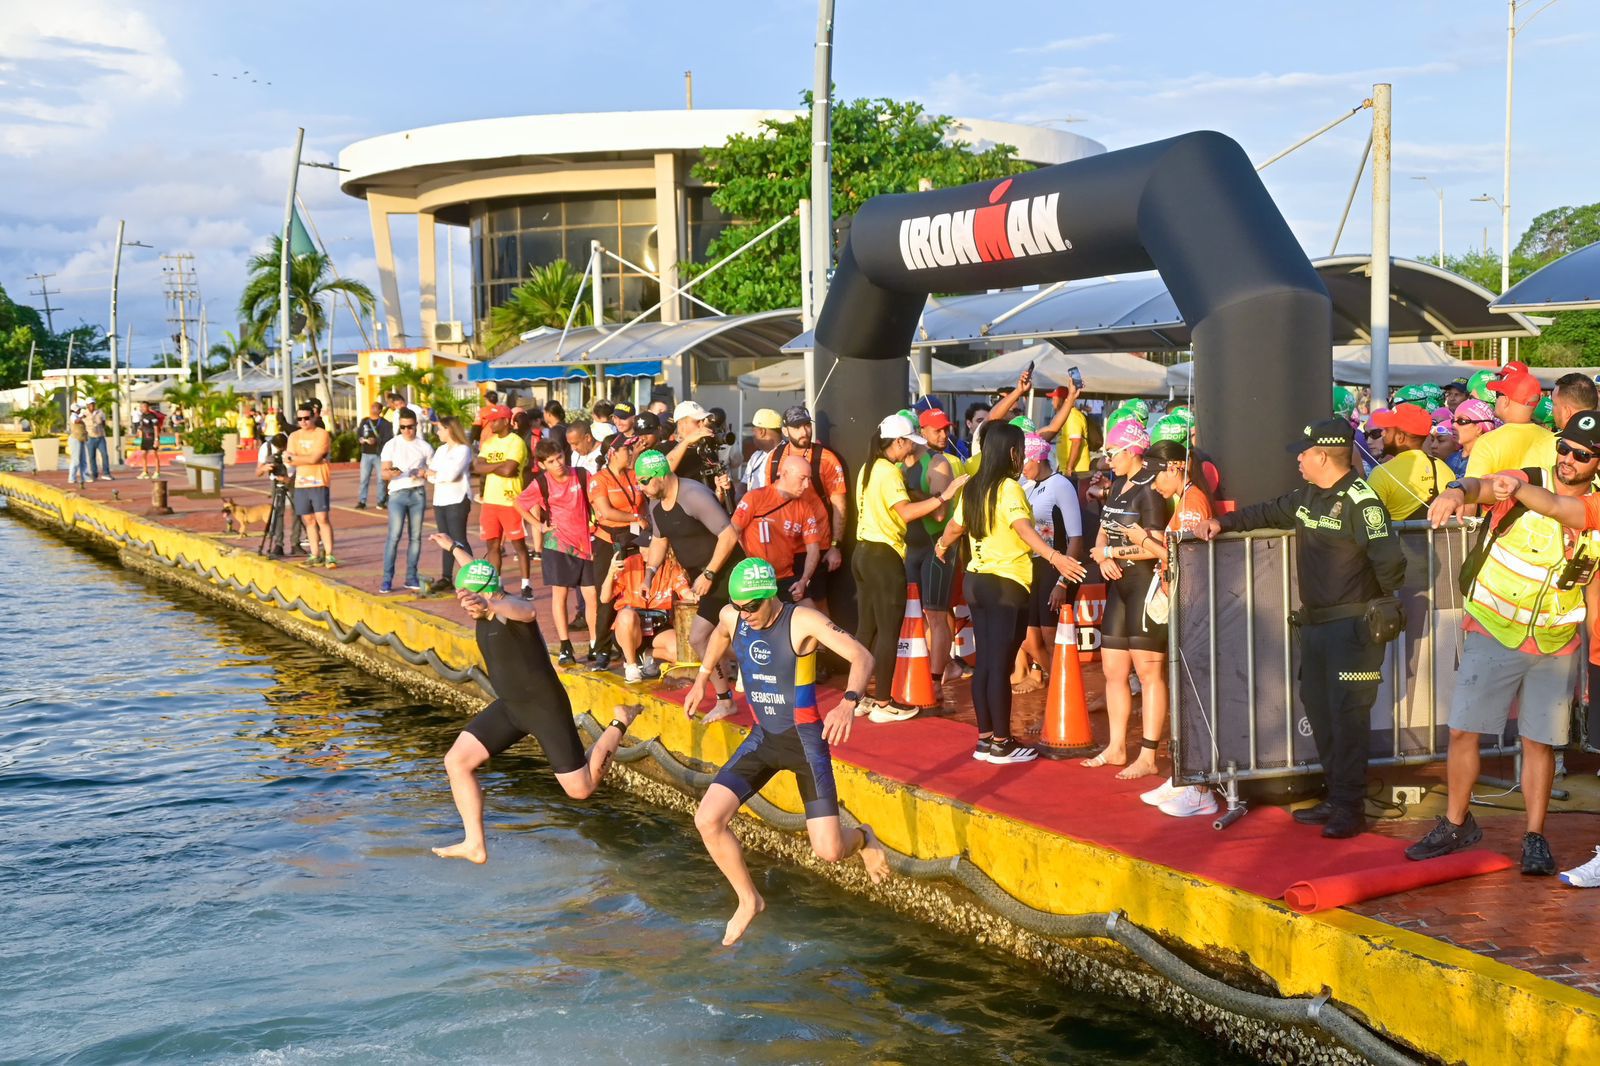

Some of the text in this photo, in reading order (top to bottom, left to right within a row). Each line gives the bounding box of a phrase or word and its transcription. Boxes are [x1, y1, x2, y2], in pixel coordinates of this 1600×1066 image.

[899, 179, 1067, 271] IRONMAN
[751, 691, 786, 705] SEBASTIAN
[764, 705, 777, 716] COL
